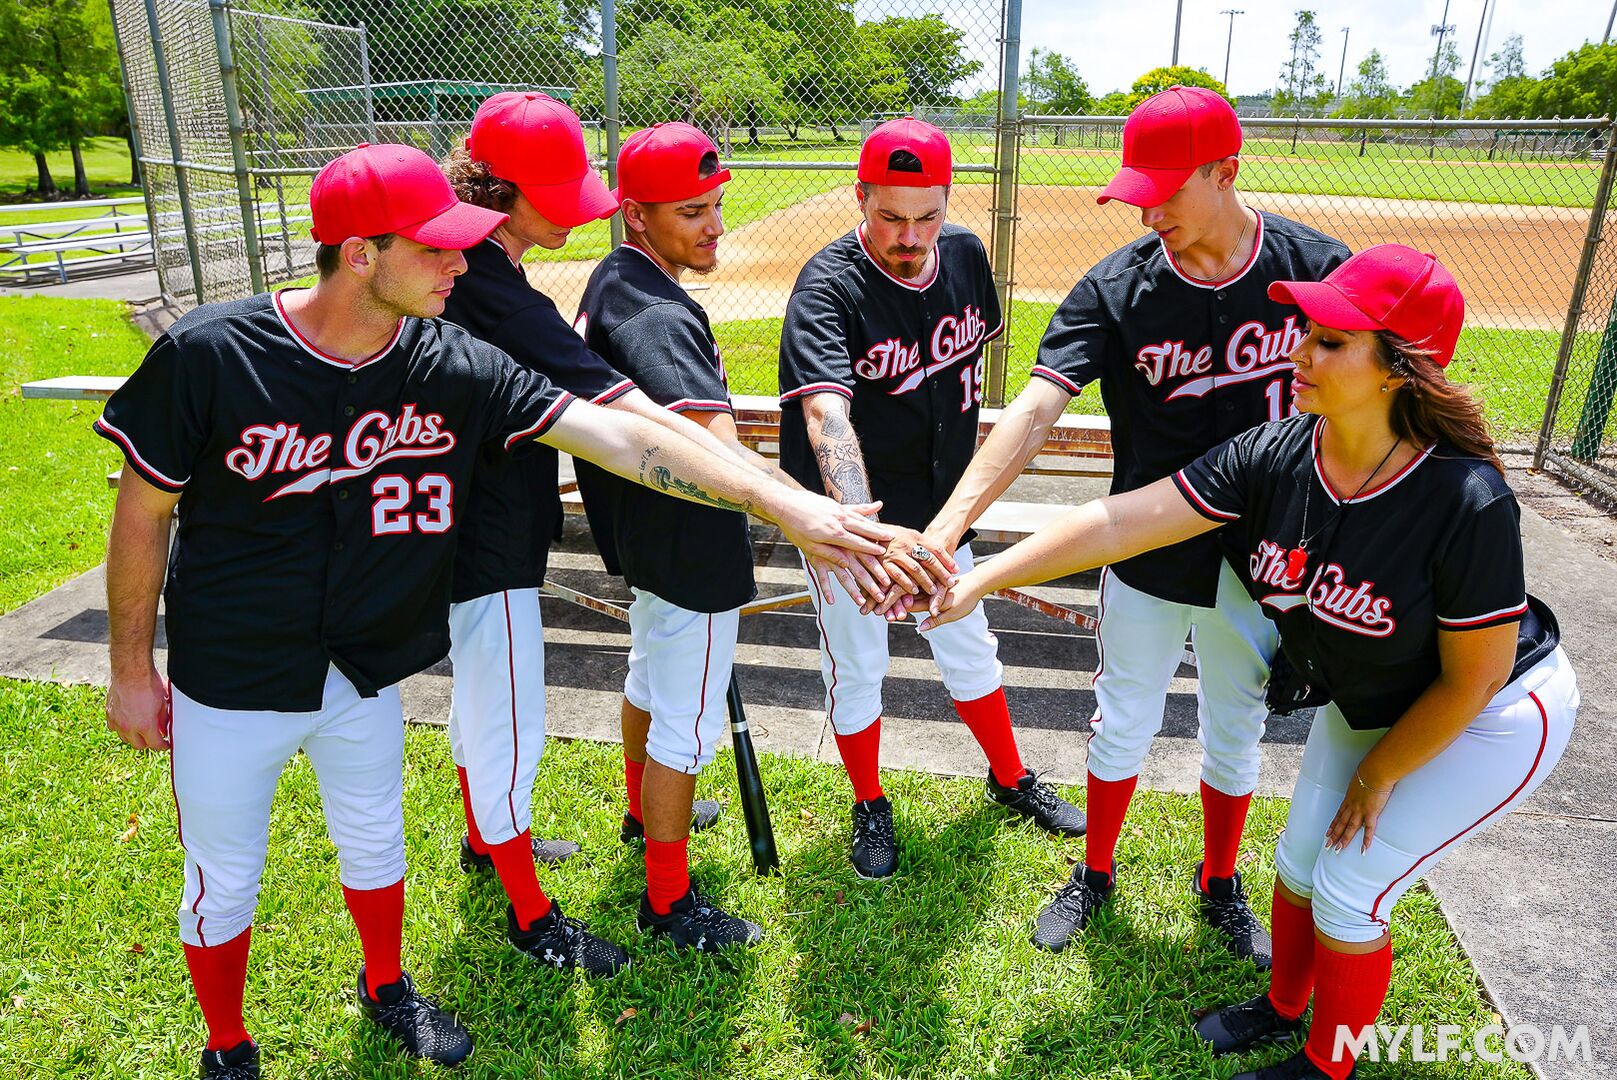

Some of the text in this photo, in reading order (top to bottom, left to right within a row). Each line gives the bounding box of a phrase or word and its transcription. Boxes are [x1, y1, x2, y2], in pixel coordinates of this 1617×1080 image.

[853, 304, 987, 381] The Cubs
[1133, 314, 1307, 387] The Cub
[1264, 378, 1300, 422] 1
[224, 402, 457, 482] The Cubs
[370, 472, 455, 538] 23
[1305, 562, 1396, 628] Cubs
